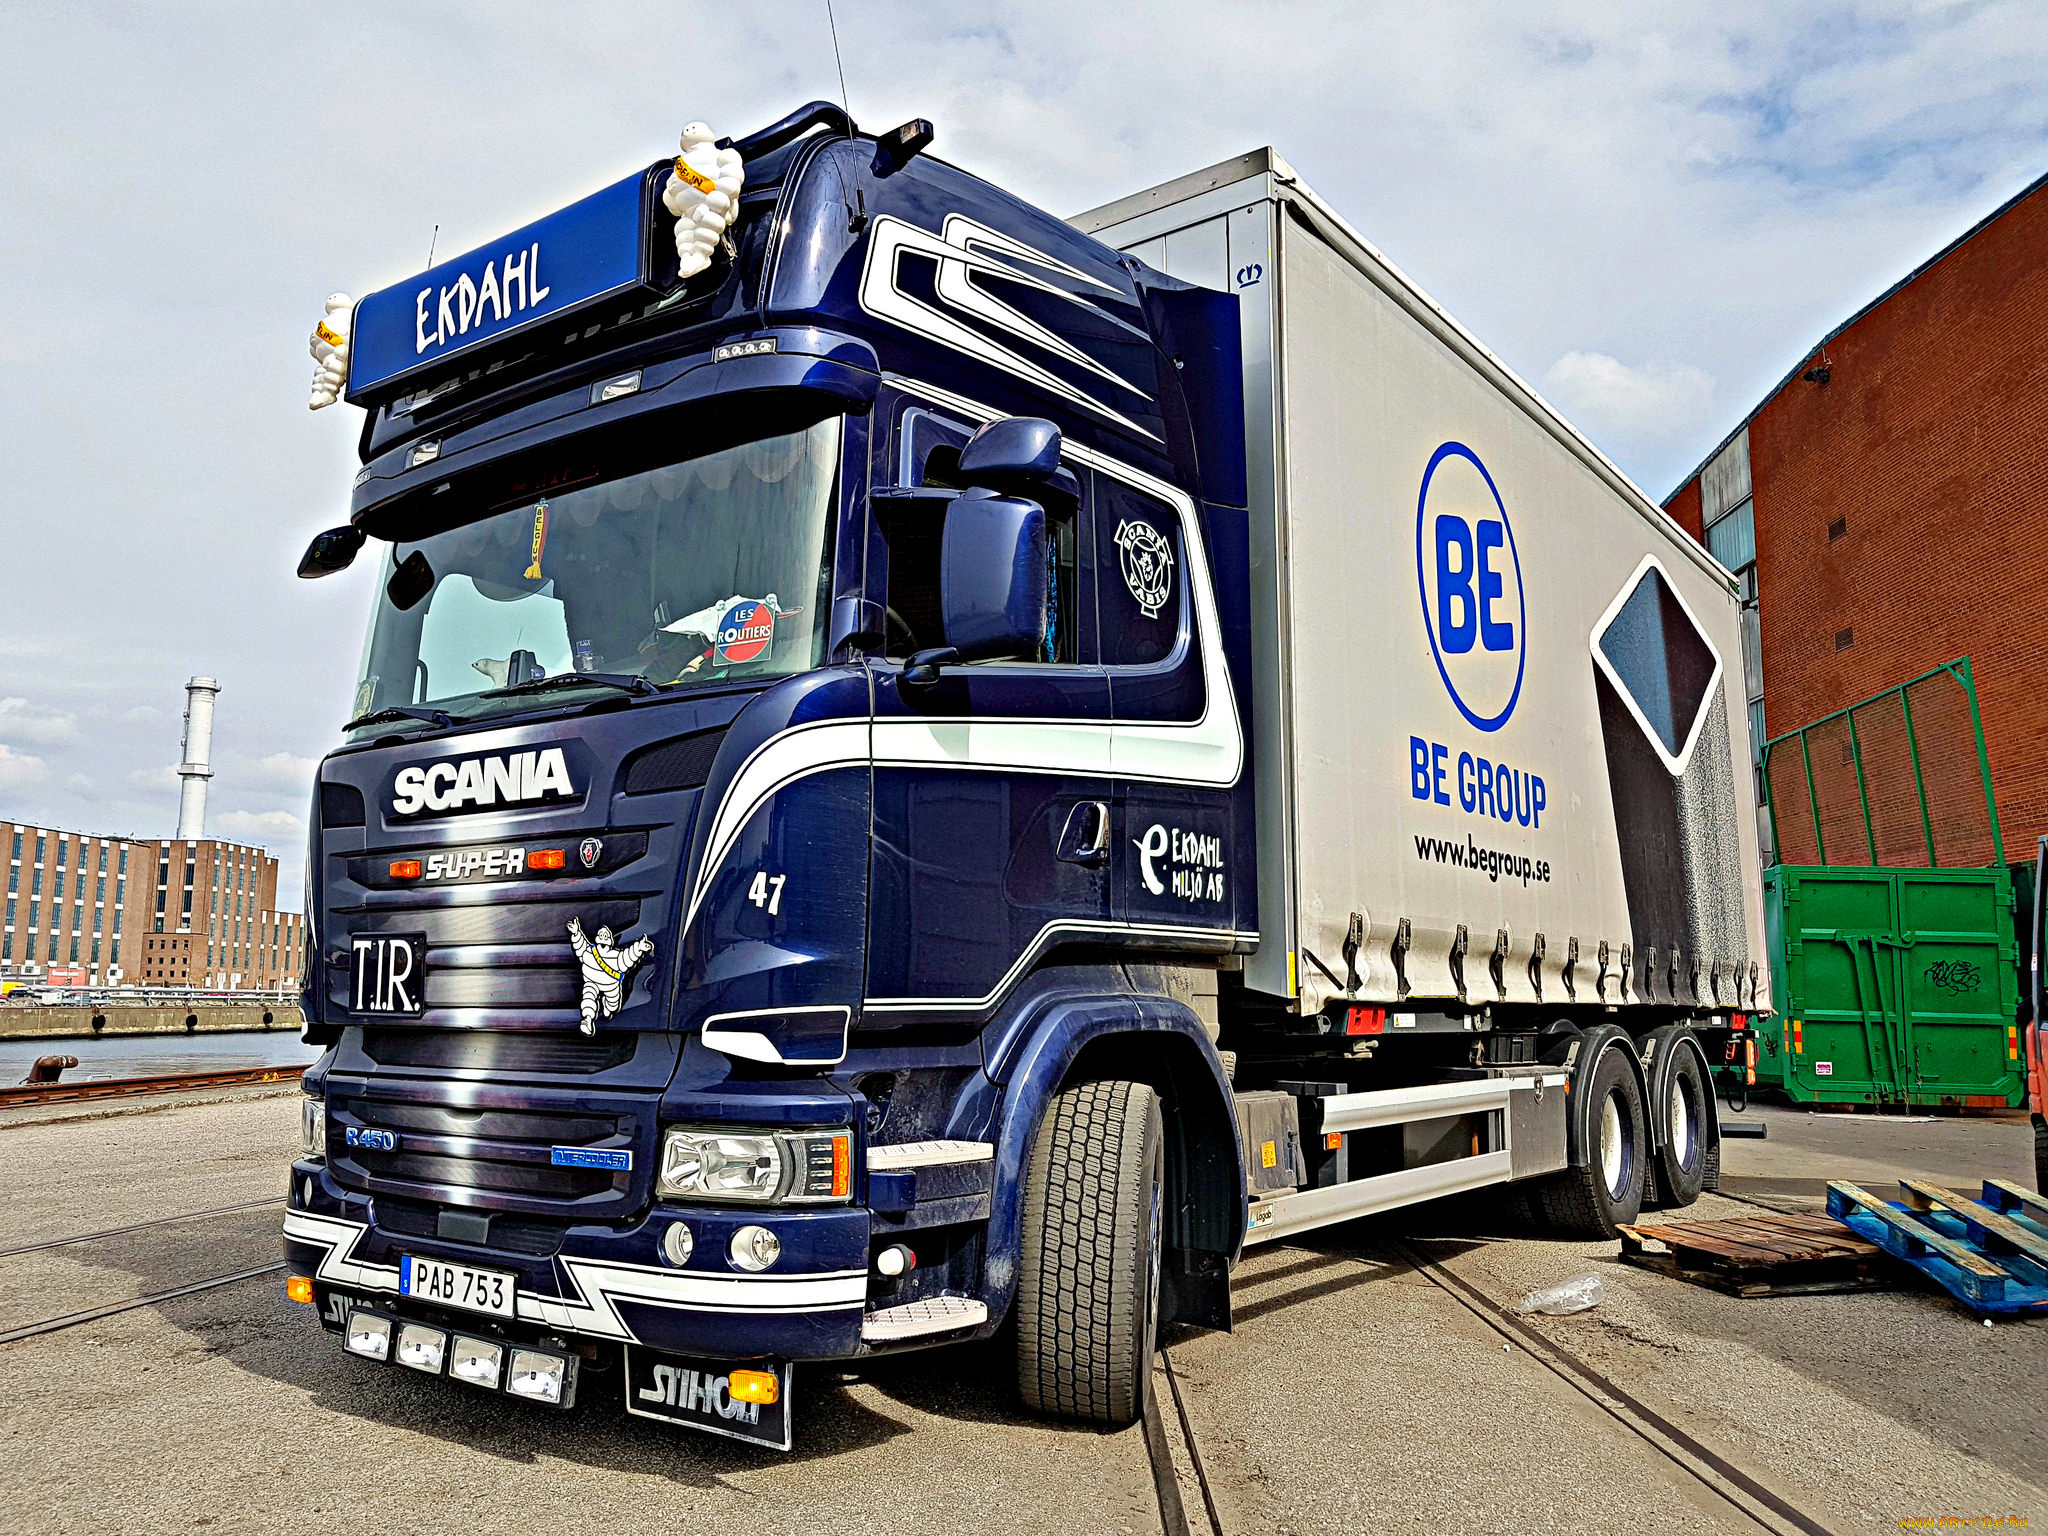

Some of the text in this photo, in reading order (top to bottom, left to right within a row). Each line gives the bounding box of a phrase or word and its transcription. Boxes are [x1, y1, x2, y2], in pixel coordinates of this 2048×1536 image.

[416, 242, 550, 354] EKDAHL
[532, 508, 543, 562] BELGIUM
[1123, 525, 1168, 567] SCANIA
[1129, 572, 1167, 605] VABIS
[1435, 514, 1514, 654] BE
[717, 624, 772, 644] ROUTIERS
[735, 608, 755, 623] LES
[393, 747, 574, 815] SCANIA
[1410, 735, 1546, 829] BE GROUP
[425, 848, 526, 880] SUPER
[1172, 828, 1224, 868] EKDAHL
[1414, 833, 1550, 888] www.begroup.se
[748, 871, 787, 916] 47
[1172, 866, 1224, 903] MILJÖ AB
[346, 1126, 394, 1151] R 450
[403, 1263, 504, 1309] S PAB 753
